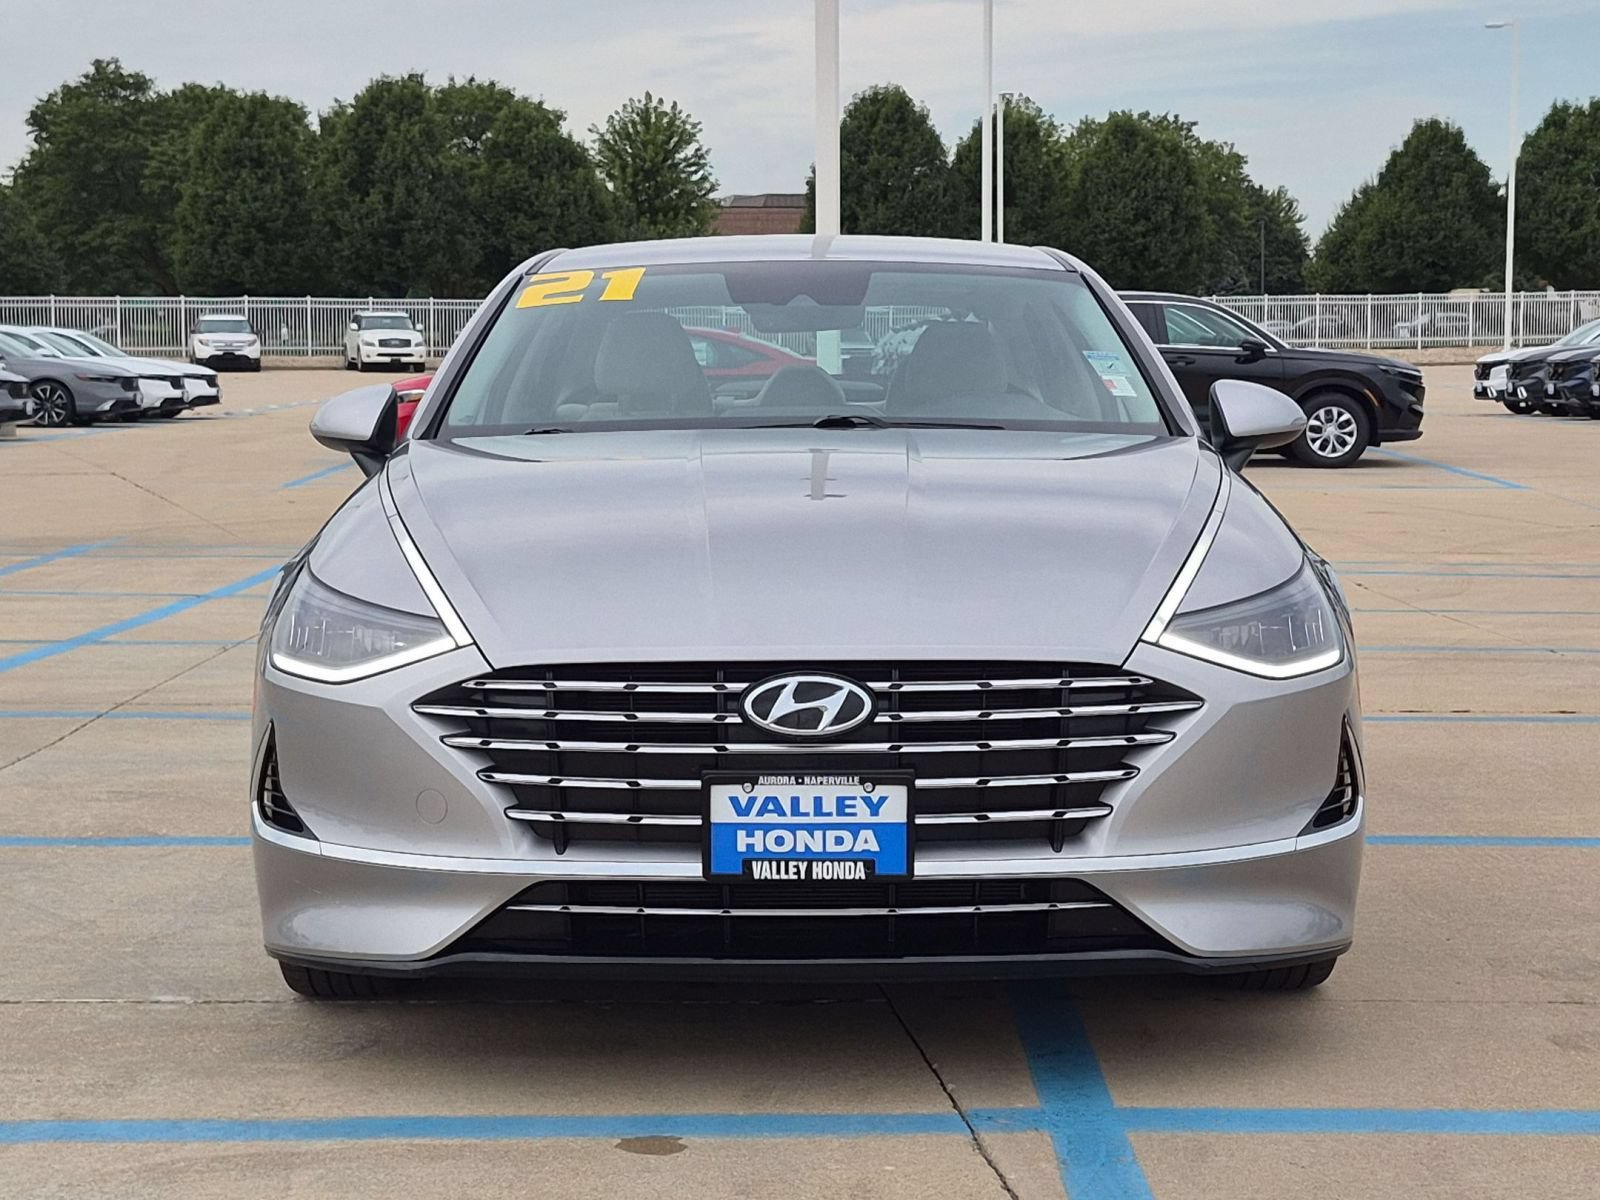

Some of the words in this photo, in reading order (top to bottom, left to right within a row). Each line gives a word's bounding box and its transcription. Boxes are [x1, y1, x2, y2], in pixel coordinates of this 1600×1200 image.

[515, 267, 646, 308] 21
[758, 776, 796, 785] AURORA
[804, 776, 860, 785] NAPERVILLE
[728, 796, 889, 817] VALLEY
[736, 829, 880, 852] HONDA
[752, 861, 810, 879] VALLEY
[812, 861, 866, 879] HONDA
